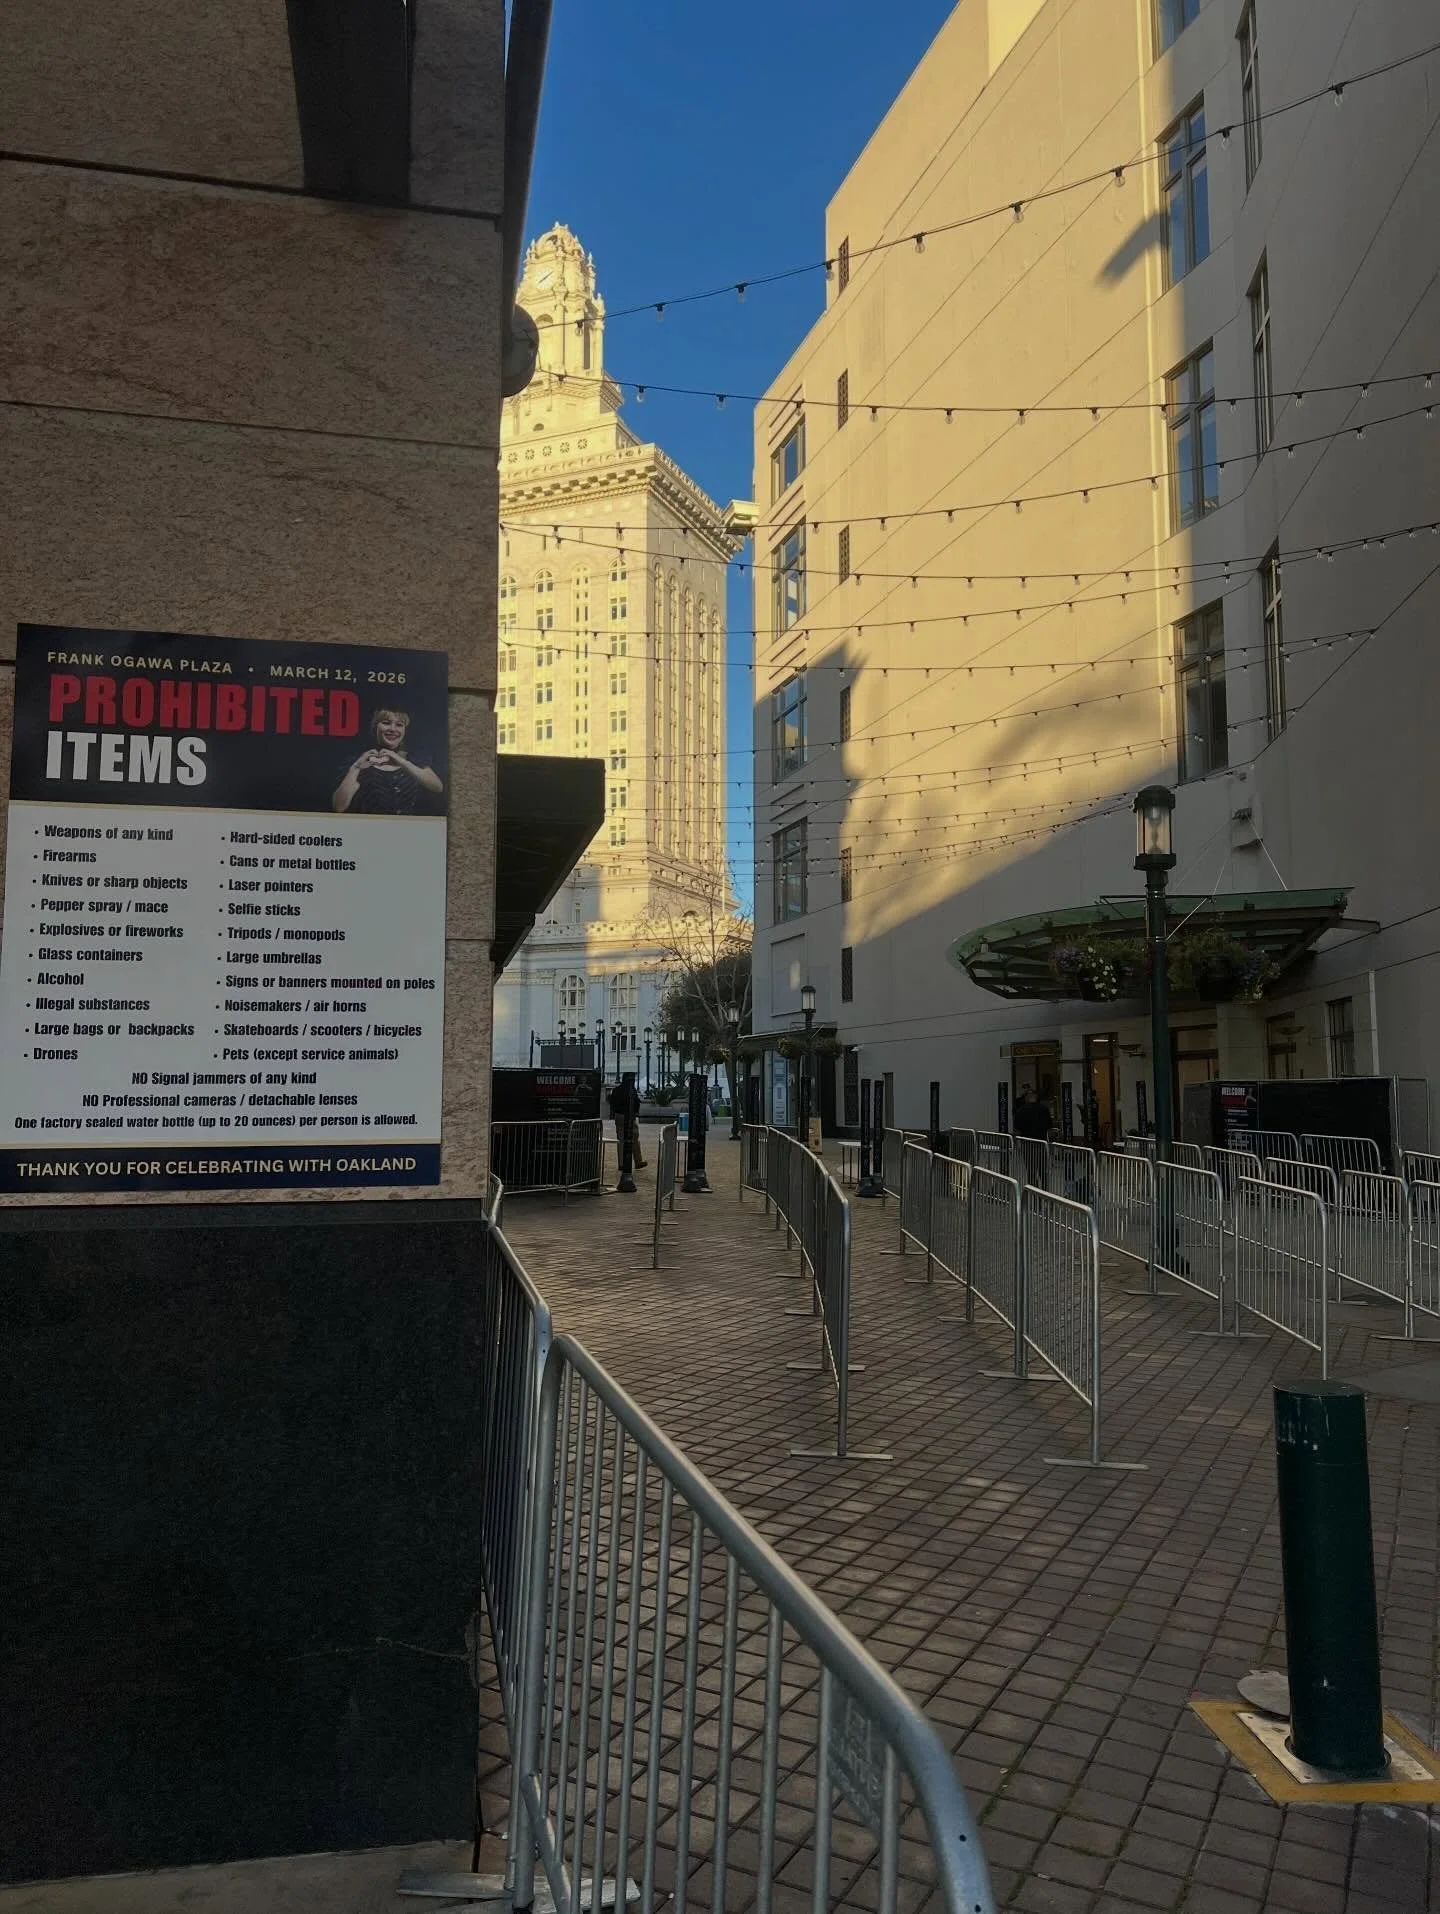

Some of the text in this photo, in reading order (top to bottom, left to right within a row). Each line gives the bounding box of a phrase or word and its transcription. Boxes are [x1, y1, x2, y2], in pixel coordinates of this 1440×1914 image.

[47, 651, 233, 674] FRANK OGAWA PLAZA
[269, 665, 407, 685] MARCH 12, 2026
[48, 674, 360, 737] PROHIBITED
[45, 730, 207, 786] ITEMS
[44, 825, 173, 841] Weapons of any kind
[230, 831, 343, 847] Hard-sided coolers
[43, 849, 97, 862] Firearms
[230, 855, 356, 871] Cans or metal bottles
[42, 874, 188, 889] Knives or sharp objects
[228, 879, 314, 893] Laser pointers
[41, 899, 169, 914] Pepper spray / mace
[228, 903, 301, 916] Selfie sticks
[39, 923, 184, 938] Explosives or fireworks
[227, 927, 345, 941] Tripods / monopods
[38, 948, 143, 961] Glass containers
[227, 951, 322, 964] Large umbrellas
[37, 973, 84, 985] Alcohol
[226, 975, 435, 990] Signs or banners mounted on poles
[36, 998, 150, 1010] Illegal substances
[225, 1000, 367, 1012] Noisemakers / air horns
[35, 1023, 195, 1036] Large bags or backpacks
[224, 1024, 422, 1037] Skateboards / scooters / bicycles
[33, 1048, 78, 1060] Drones
[223, 1048, 399, 1061] Pets (except service animals)
[132, 1071, 317, 1087] NO Signal jammers of any kind
[536, 1075, 576, 1084] WELCOME
[82, 1093, 358, 1107] NO Professional cameras / detachable lenses
[14, 1113, 418, 1130] One factory sealed water bottle (up to 20 ounces) per person is allowed.
[17, 1157, 417, 1177] THANK YOU FOR CELEBRATING WITH OAKLAND
